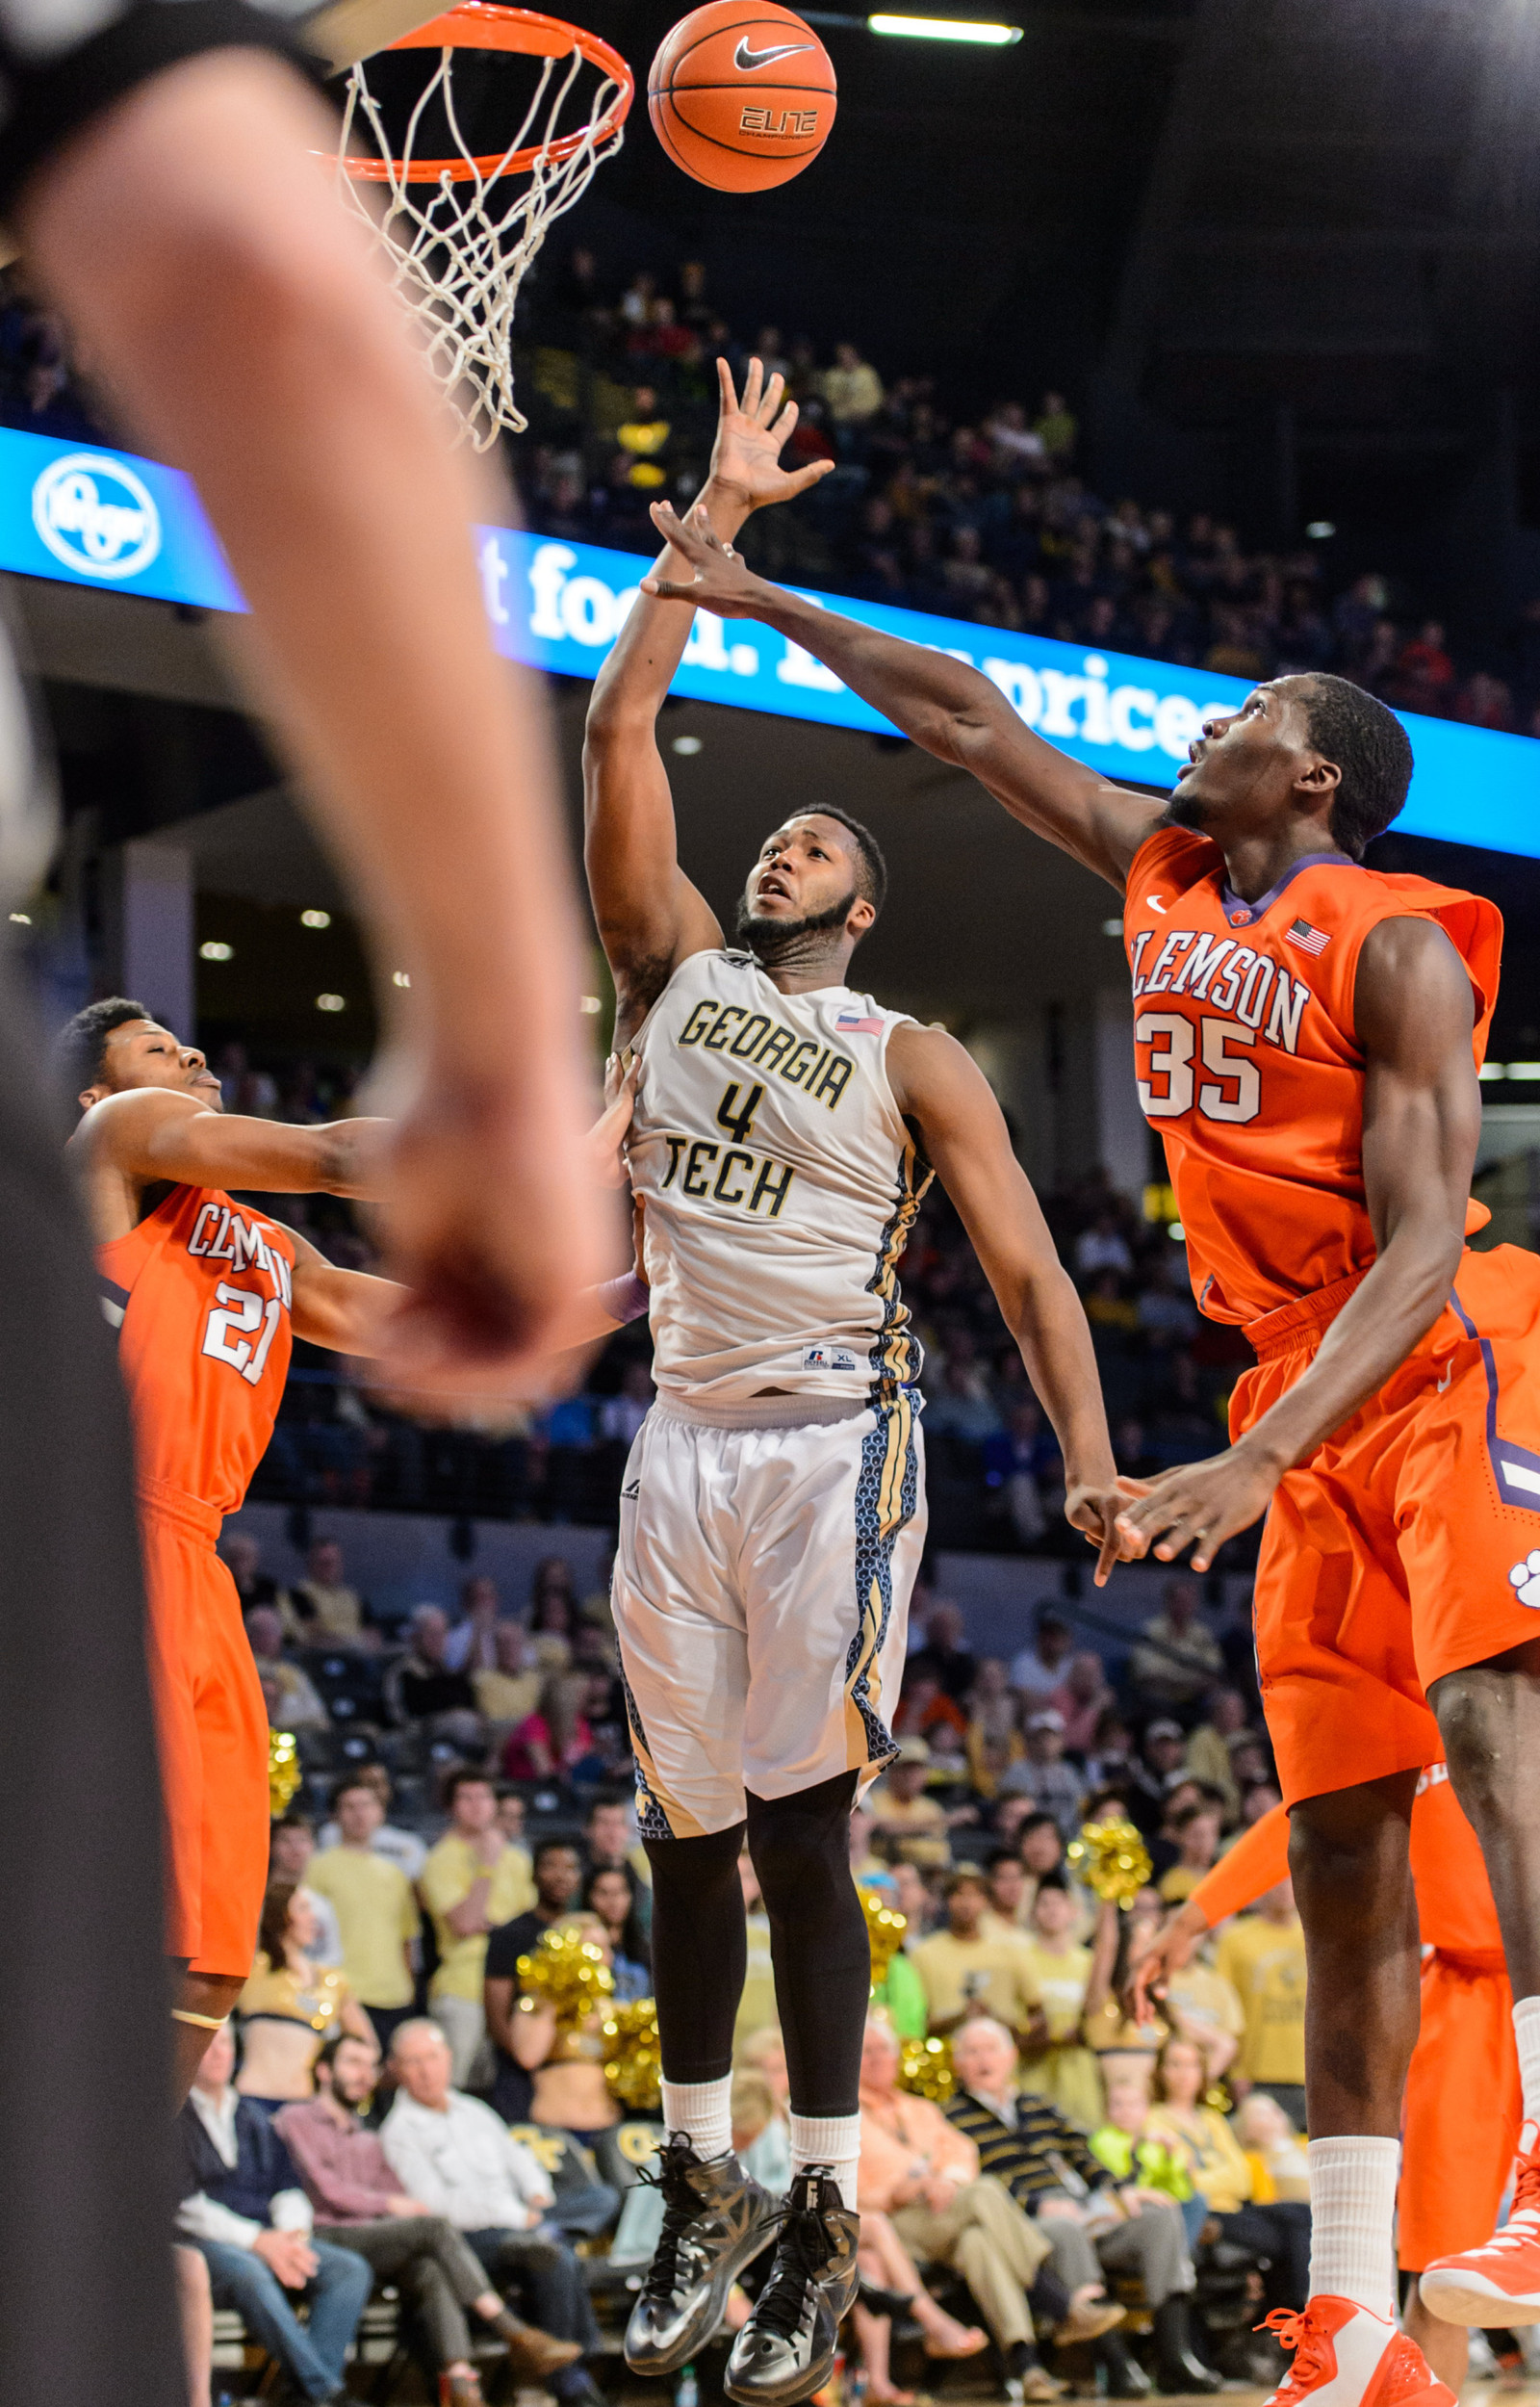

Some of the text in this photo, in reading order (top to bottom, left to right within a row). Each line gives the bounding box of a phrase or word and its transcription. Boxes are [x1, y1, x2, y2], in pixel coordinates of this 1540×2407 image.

[740, 106, 817, 134] ELITE
[1132, 930, 1311, 1055] LEMSON
[678, 999, 856, 1112] GEORGIA
[1135, 1011, 1261, 1124] 35
[715, 1080, 766, 1144] 4
[660, 1135, 796, 1219] TECH
[200, 1280, 281, 1387] 21
[837, 1354, 852, 1362] XL
